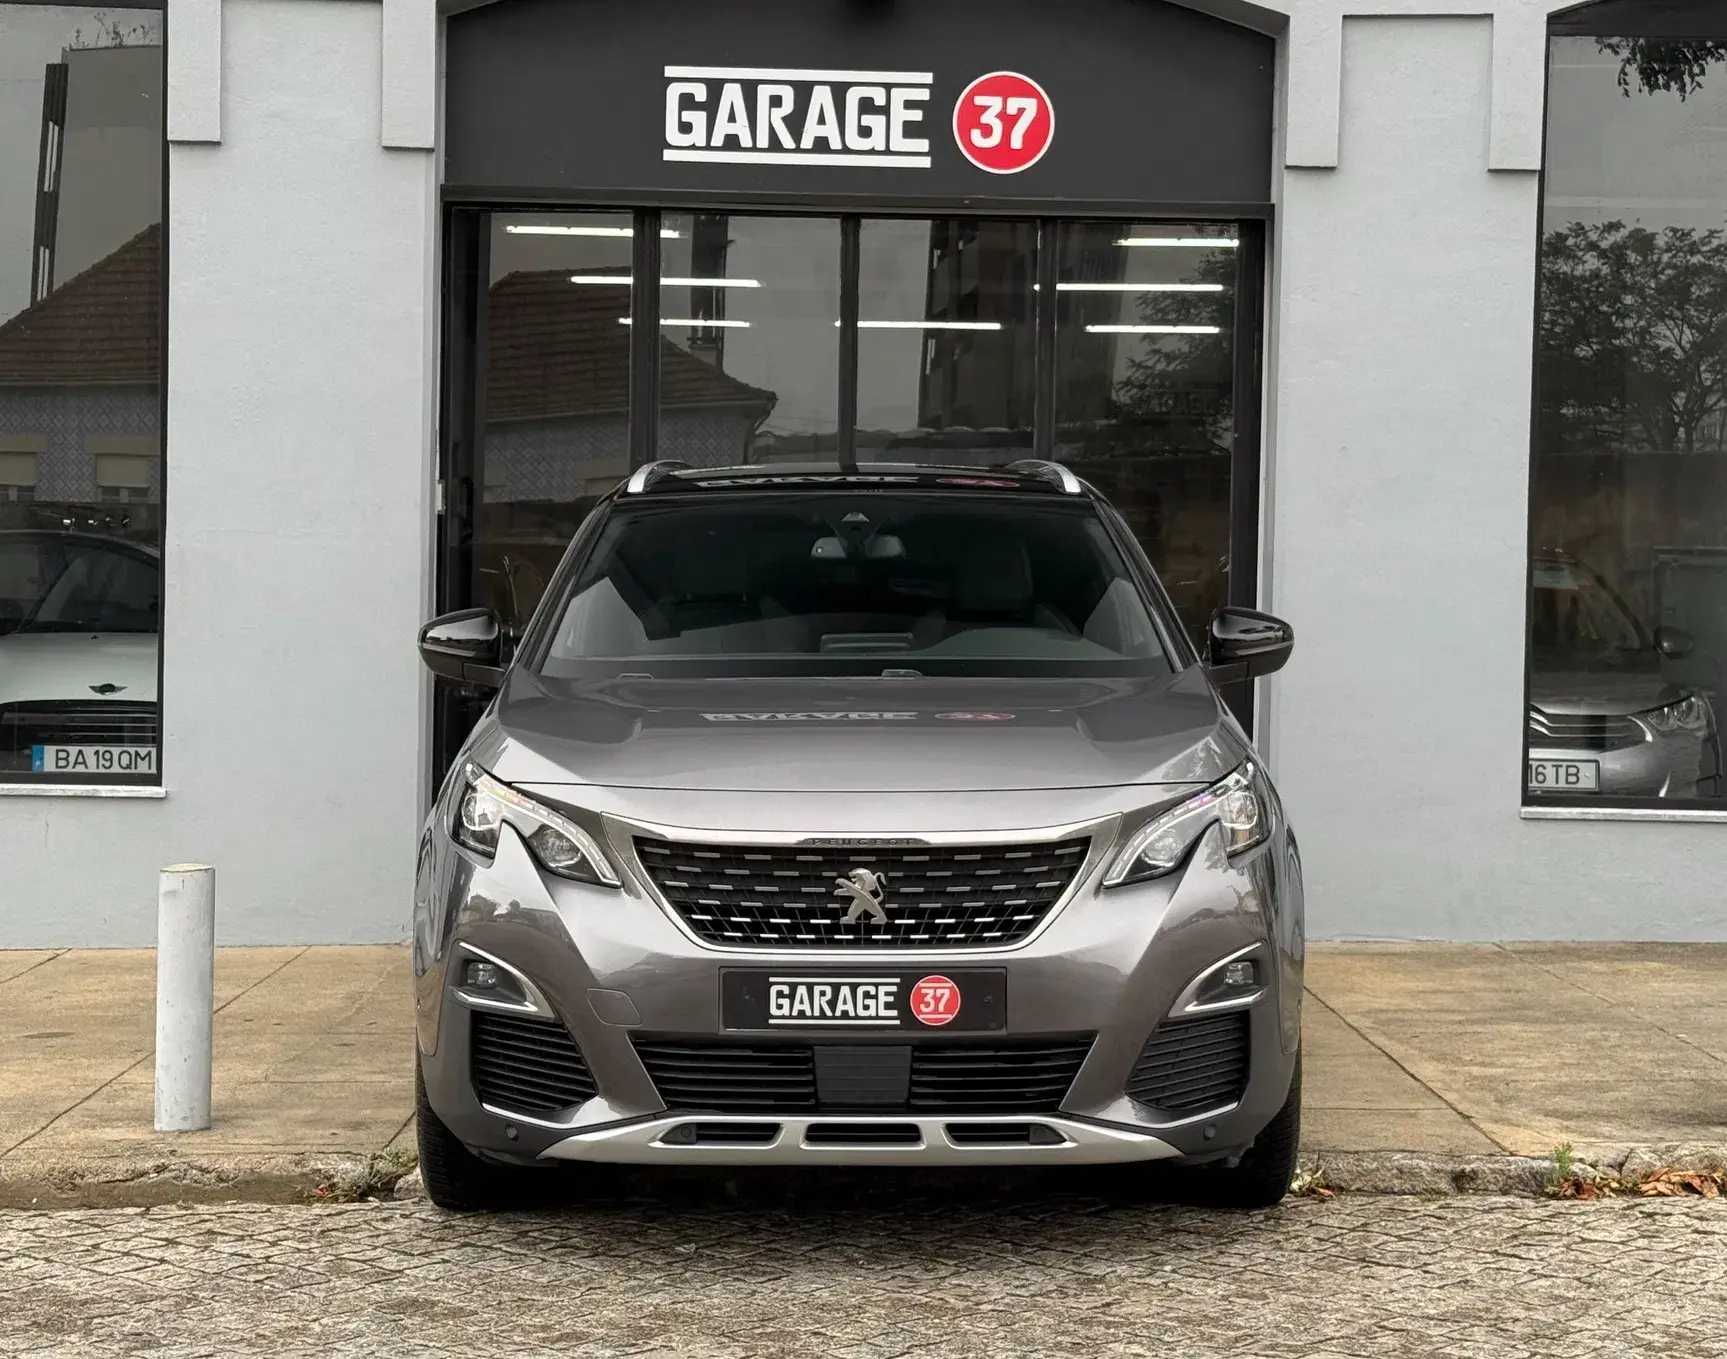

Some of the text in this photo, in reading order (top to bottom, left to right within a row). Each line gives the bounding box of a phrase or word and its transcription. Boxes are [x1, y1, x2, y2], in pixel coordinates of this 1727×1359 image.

[665, 82, 1038, 152] GARAGE 37
[811, 838, 911, 847] PEUGEOT
[769, 984, 950, 1017] GARAGE 37
